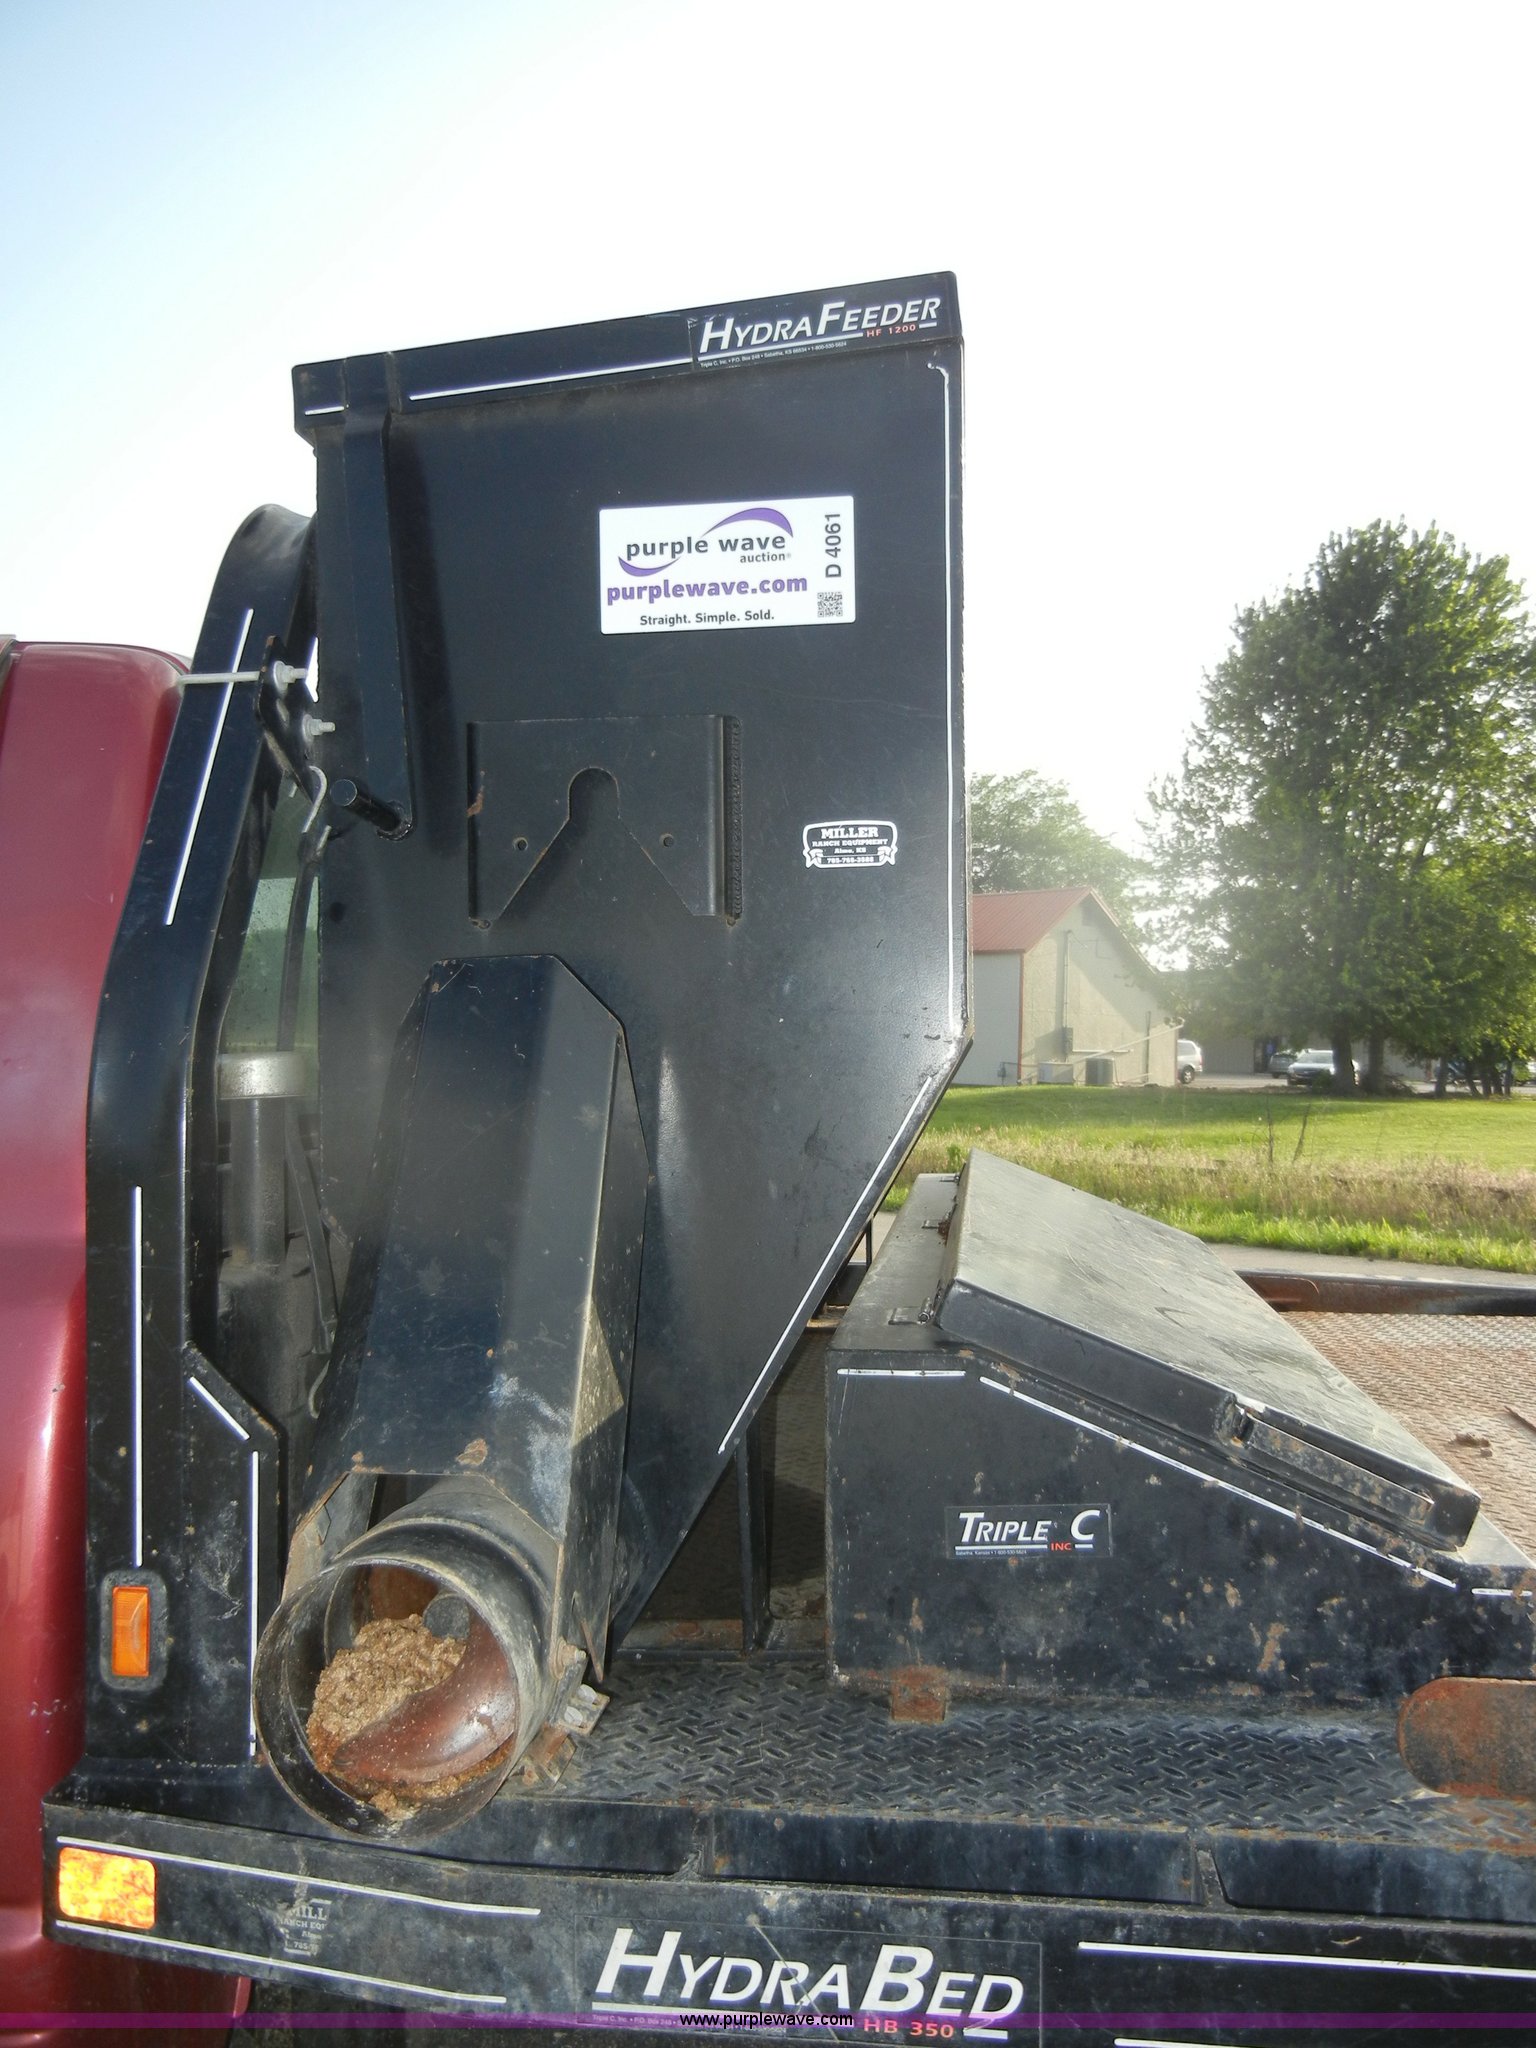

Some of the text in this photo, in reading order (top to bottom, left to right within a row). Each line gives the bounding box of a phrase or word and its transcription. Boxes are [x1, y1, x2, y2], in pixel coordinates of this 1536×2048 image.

[866, 324, 916, 338] HF 1200
[626, 535, 786, 560] purple wave
[824, 513, 842, 578] D 4061
[607, 577, 808, 605] purplewave.com
[640, 609, 775, 627] Straight. Simple. Sold.
[820, 826, 879, 839] MILLER
[842, 838, 888, 847] EQUIPMENT
[959, 1509, 1101, 1543] TRIPLE C
[1050, 1542, 1072, 1551] INC
[863, 2018, 954, 2039] HB 350
